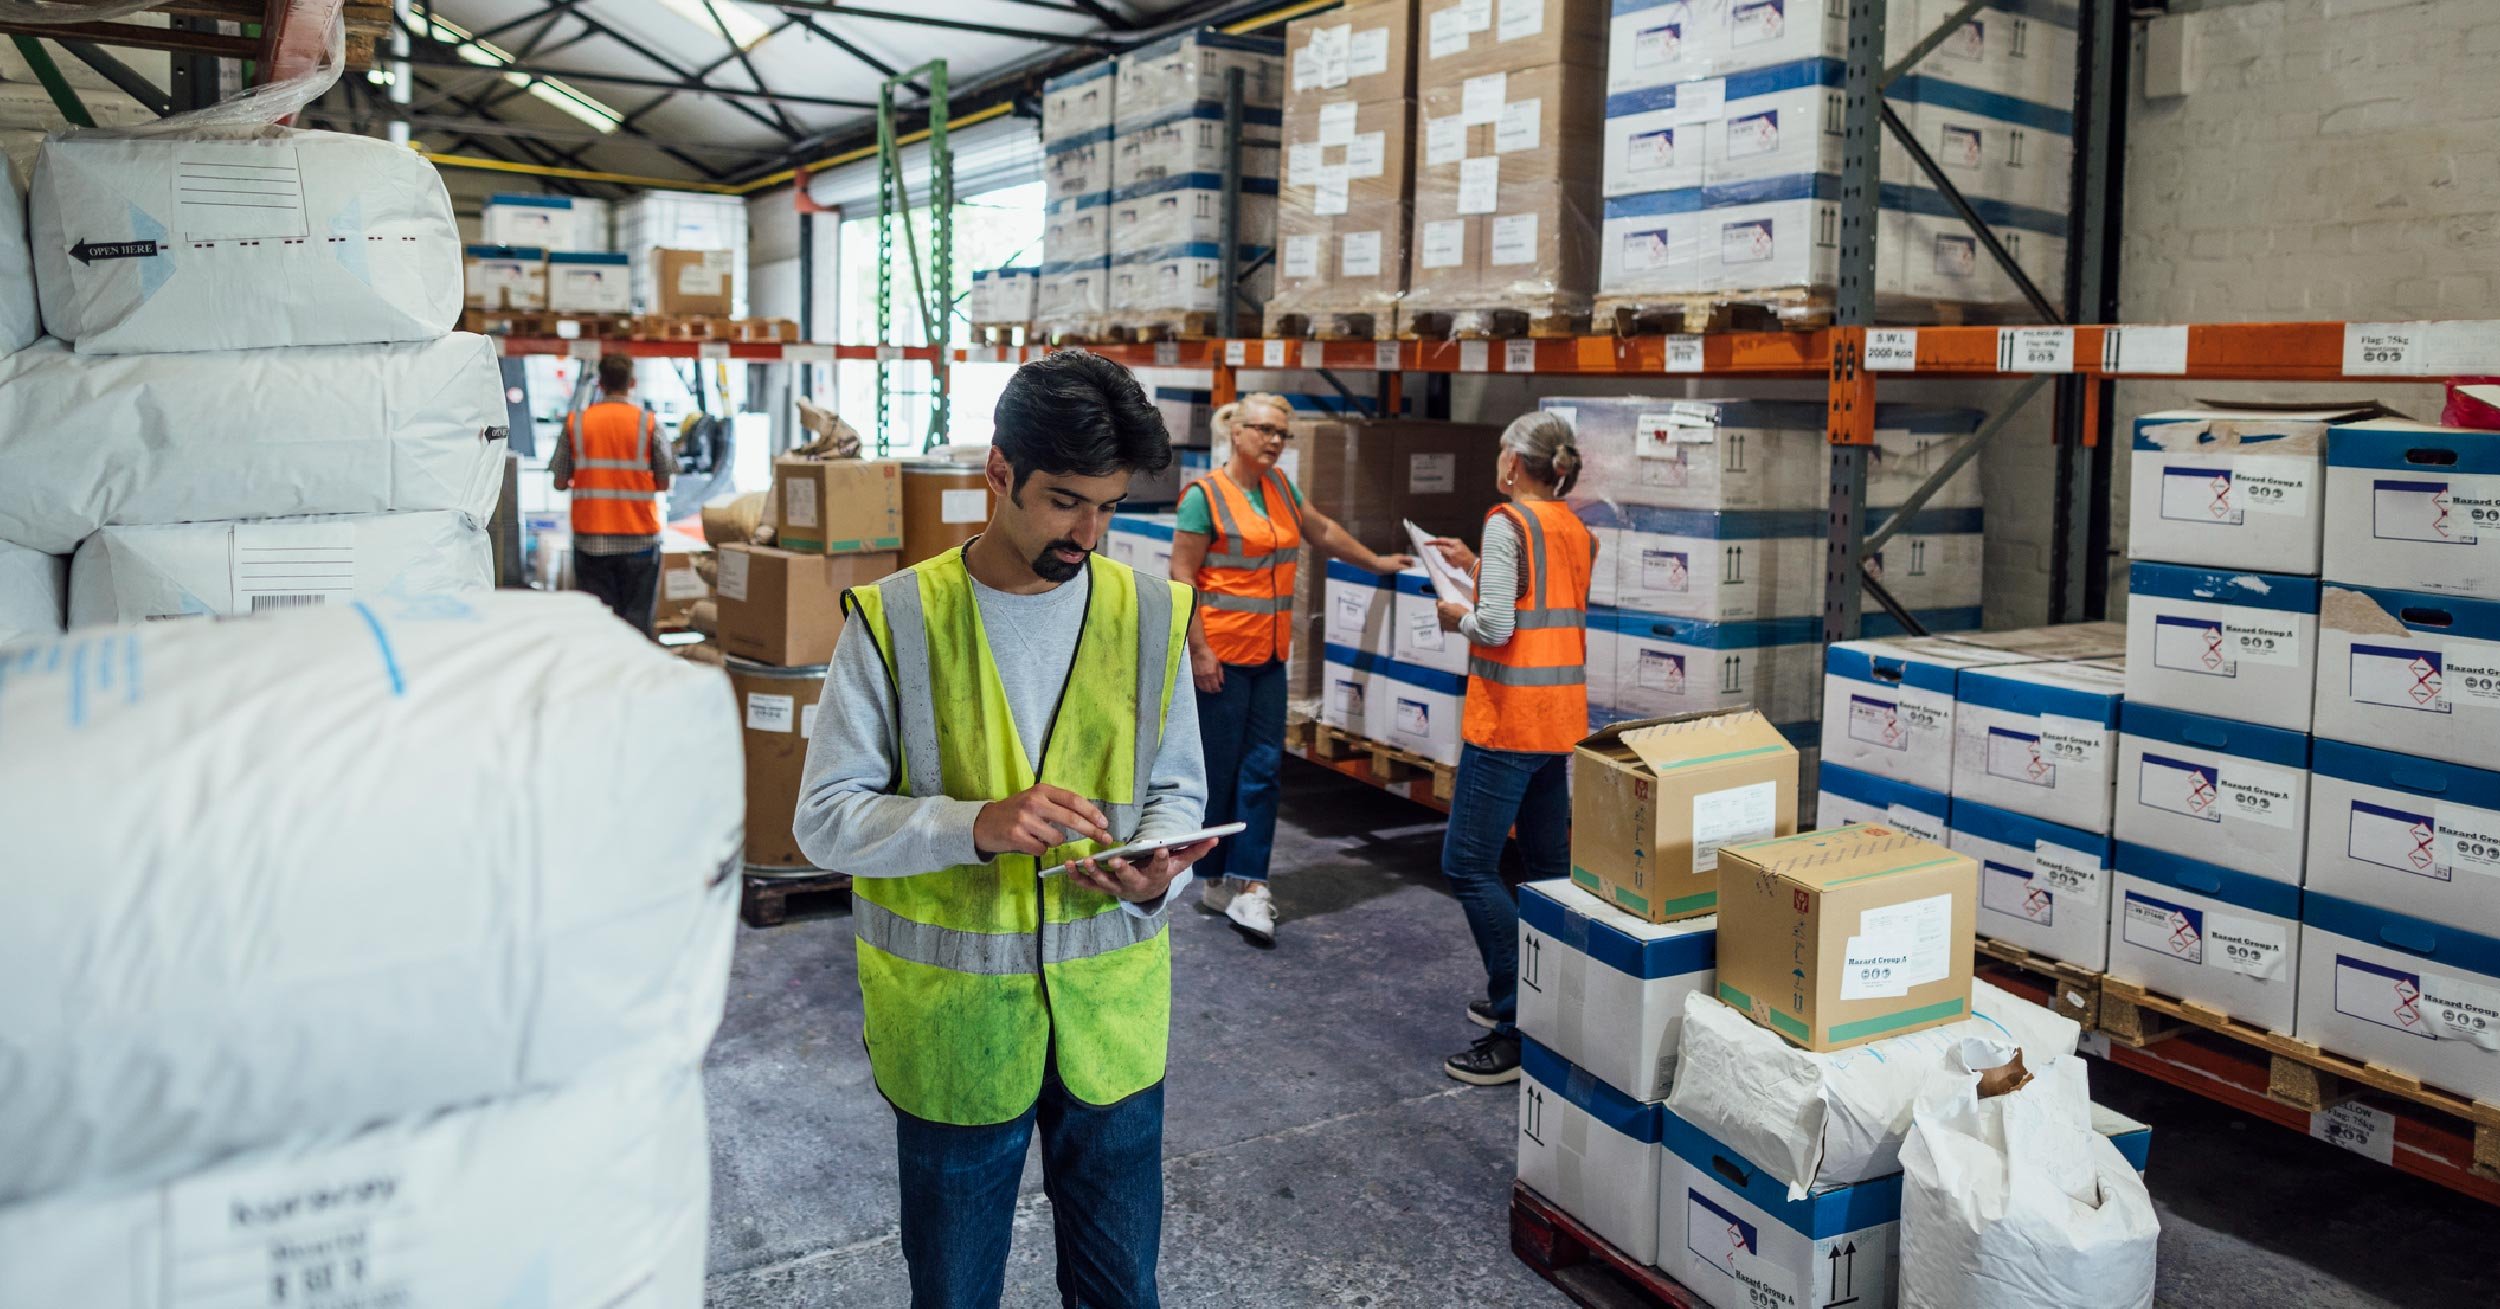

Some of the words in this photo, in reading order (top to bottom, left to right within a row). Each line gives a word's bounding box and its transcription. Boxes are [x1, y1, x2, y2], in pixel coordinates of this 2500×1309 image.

[89, 246, 119, 256] OPEN
[121, 244, 153, 255] HERE
[1868, 347, 1892, 358] 2000
[2235, 473, 2266, 483] Hazard
[2453, 497, 2491, 506] Hazard
[2226, 624, 2256, 635] Hazard
[2446, 663, 2484, 675] Hazard
[2221, 780, 2252, 792] Hazard
[2439, 826, 2478, 840] Hazard
[2479, 834, 2500, 844] Gro
[2212, 931, 2242, 944] Hazard
[2244, 938, 2271, 950] Group
[1848, 957, 1876, 965] Hazard
[2424, 994, 2462, 1008] Hazard
[2465, 1003, 2499, 1017] Group
[1735, 1269, 1761, 1288] Hazard
[1762, 1281, 1786, 1302] Group
